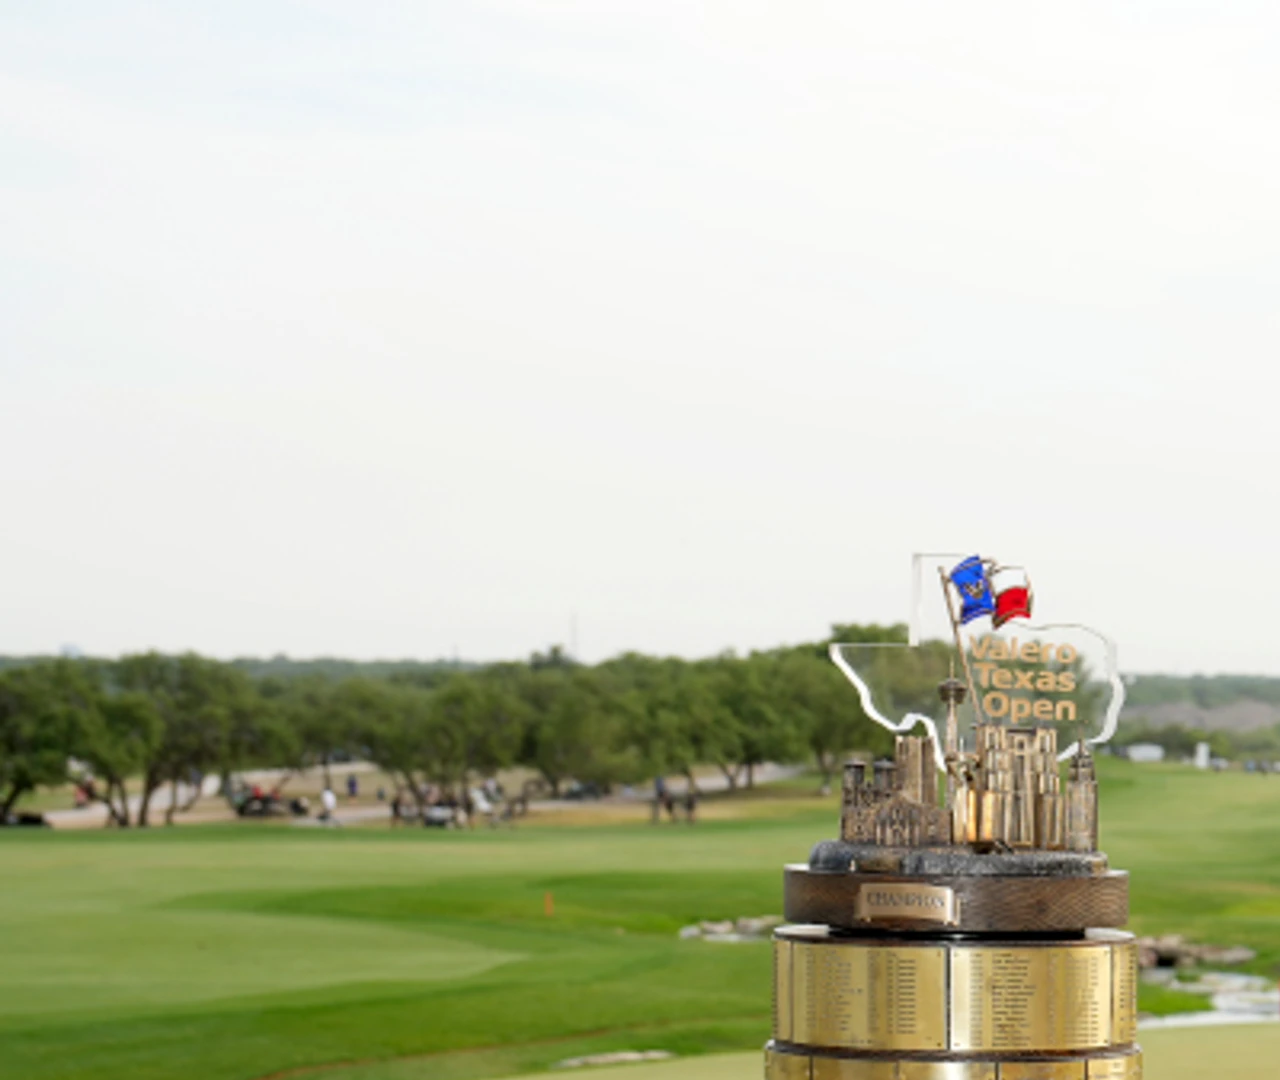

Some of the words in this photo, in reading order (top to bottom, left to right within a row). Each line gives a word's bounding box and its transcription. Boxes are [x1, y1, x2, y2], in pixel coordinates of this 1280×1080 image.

[969, 635, 1078, 664] Valero
[973, 662, 1076, 692] Texas
[982, 692, 1077, 723] Open
[867, 891, 945, 909] CHAMPION
